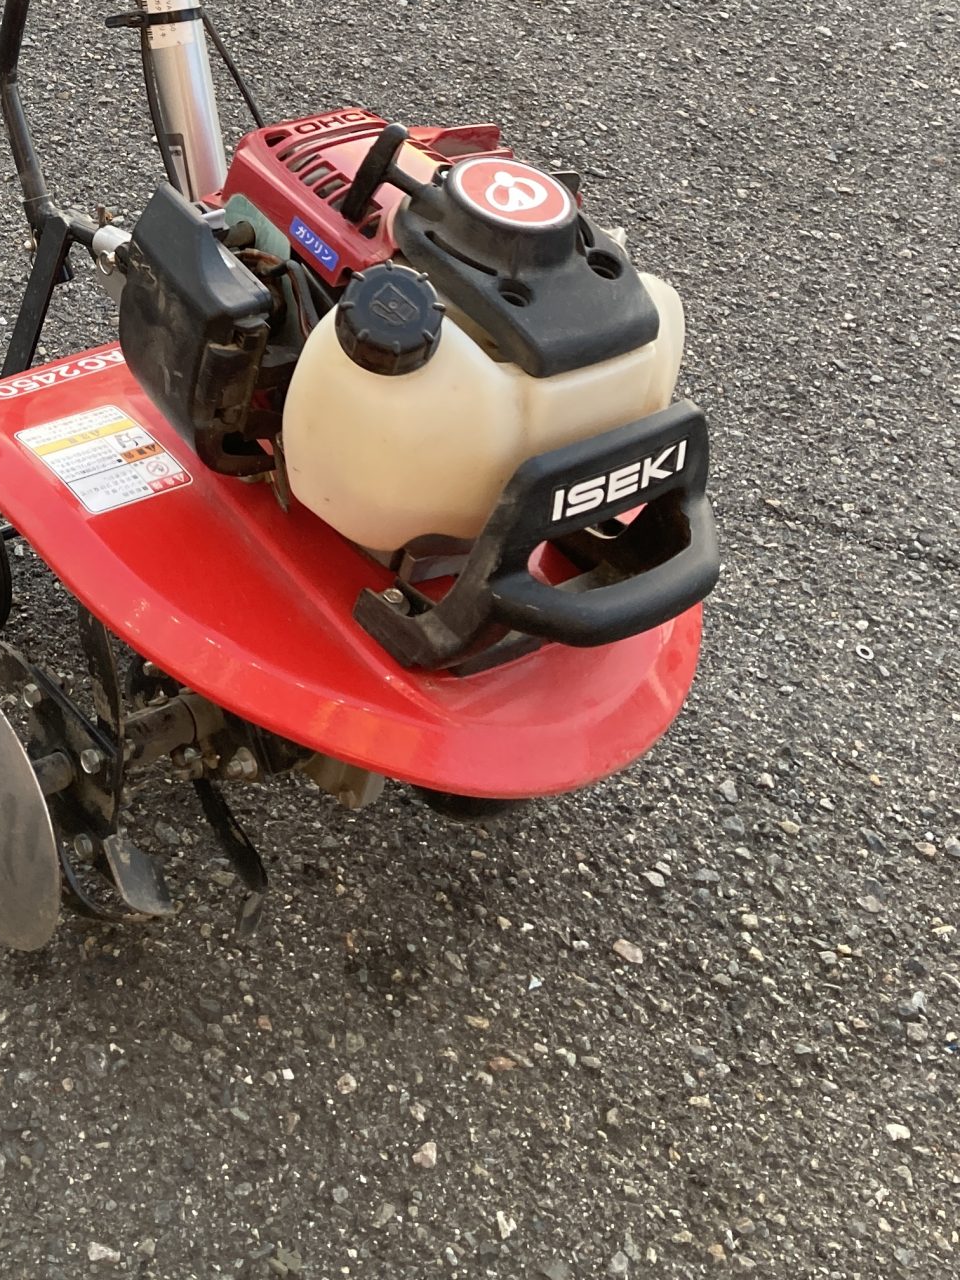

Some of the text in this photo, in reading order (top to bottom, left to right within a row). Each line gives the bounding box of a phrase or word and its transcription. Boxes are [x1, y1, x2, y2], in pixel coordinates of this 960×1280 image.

[294, 112, 366, 135] OHC
[295, 226, 332, 260] ガソリン
[551, 439, 688, 522] ISEKI
